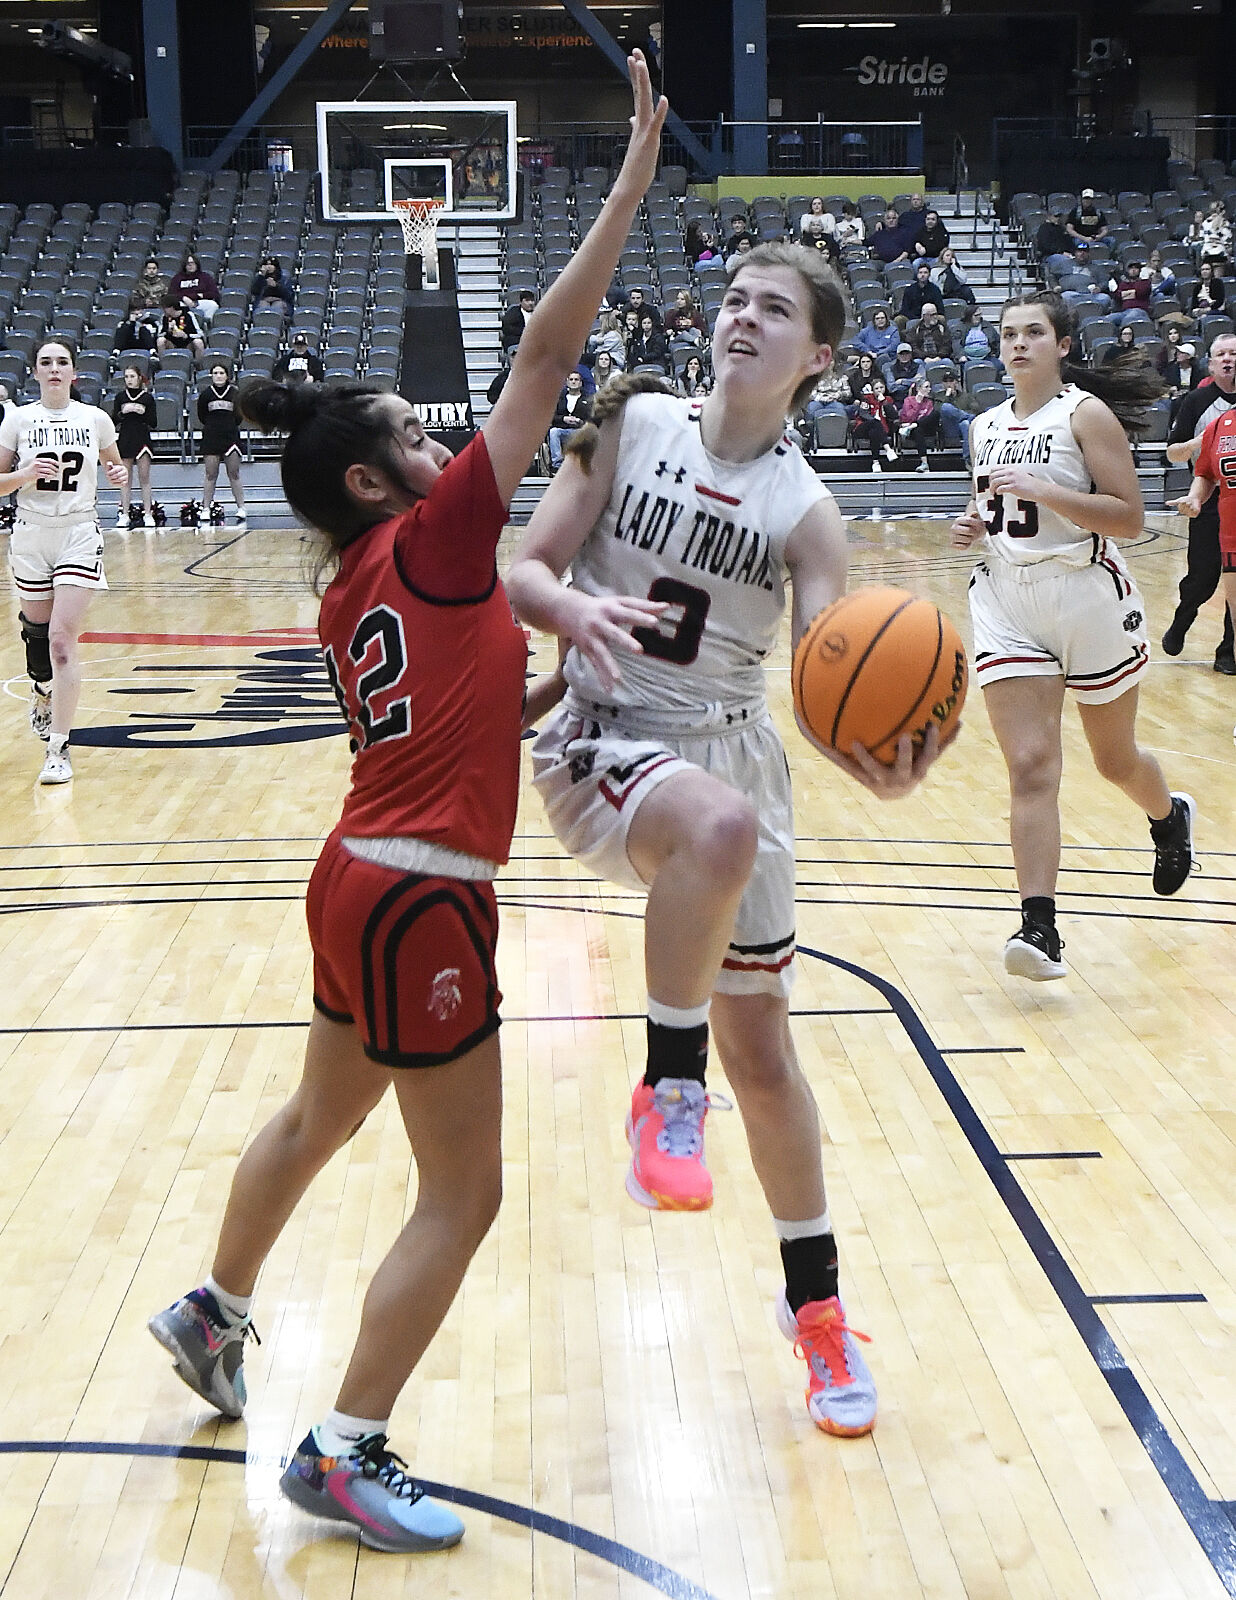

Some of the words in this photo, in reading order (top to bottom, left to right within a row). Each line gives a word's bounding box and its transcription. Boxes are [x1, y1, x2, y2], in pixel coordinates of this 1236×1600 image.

[857, 55, 948, 85] Stride
[913, 87, 945, 97] BANK
[28, 427, 49, 448] LADY
[53, 427, 90, 447] TROJANS
[997, 433, 1053, 465] TROJANS
[35, 451, 84, 492] 22
[976, 475, 1039, 538] 33
[615, 484, 685, 555] LADY
[681, 510, 774, 591] TROJAN
[630, 576, 712, 666] 3
